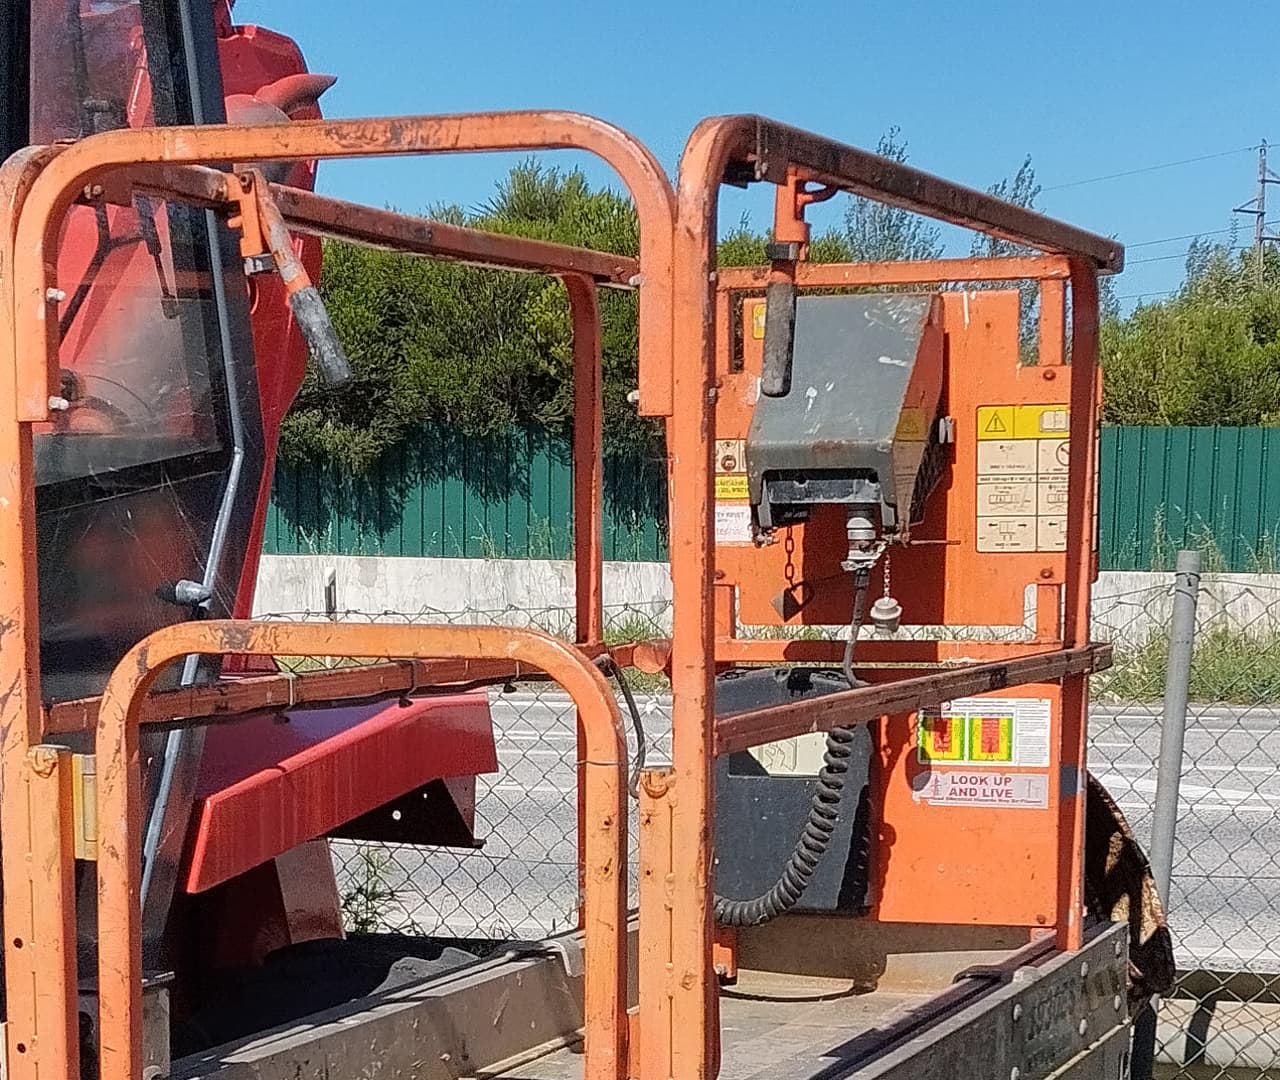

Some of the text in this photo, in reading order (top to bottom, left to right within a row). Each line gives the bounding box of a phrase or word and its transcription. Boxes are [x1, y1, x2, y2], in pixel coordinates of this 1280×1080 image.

[951, 775, 1012, 786] LOOK UP
[949, 787, 1014, 798] AND LIVE
